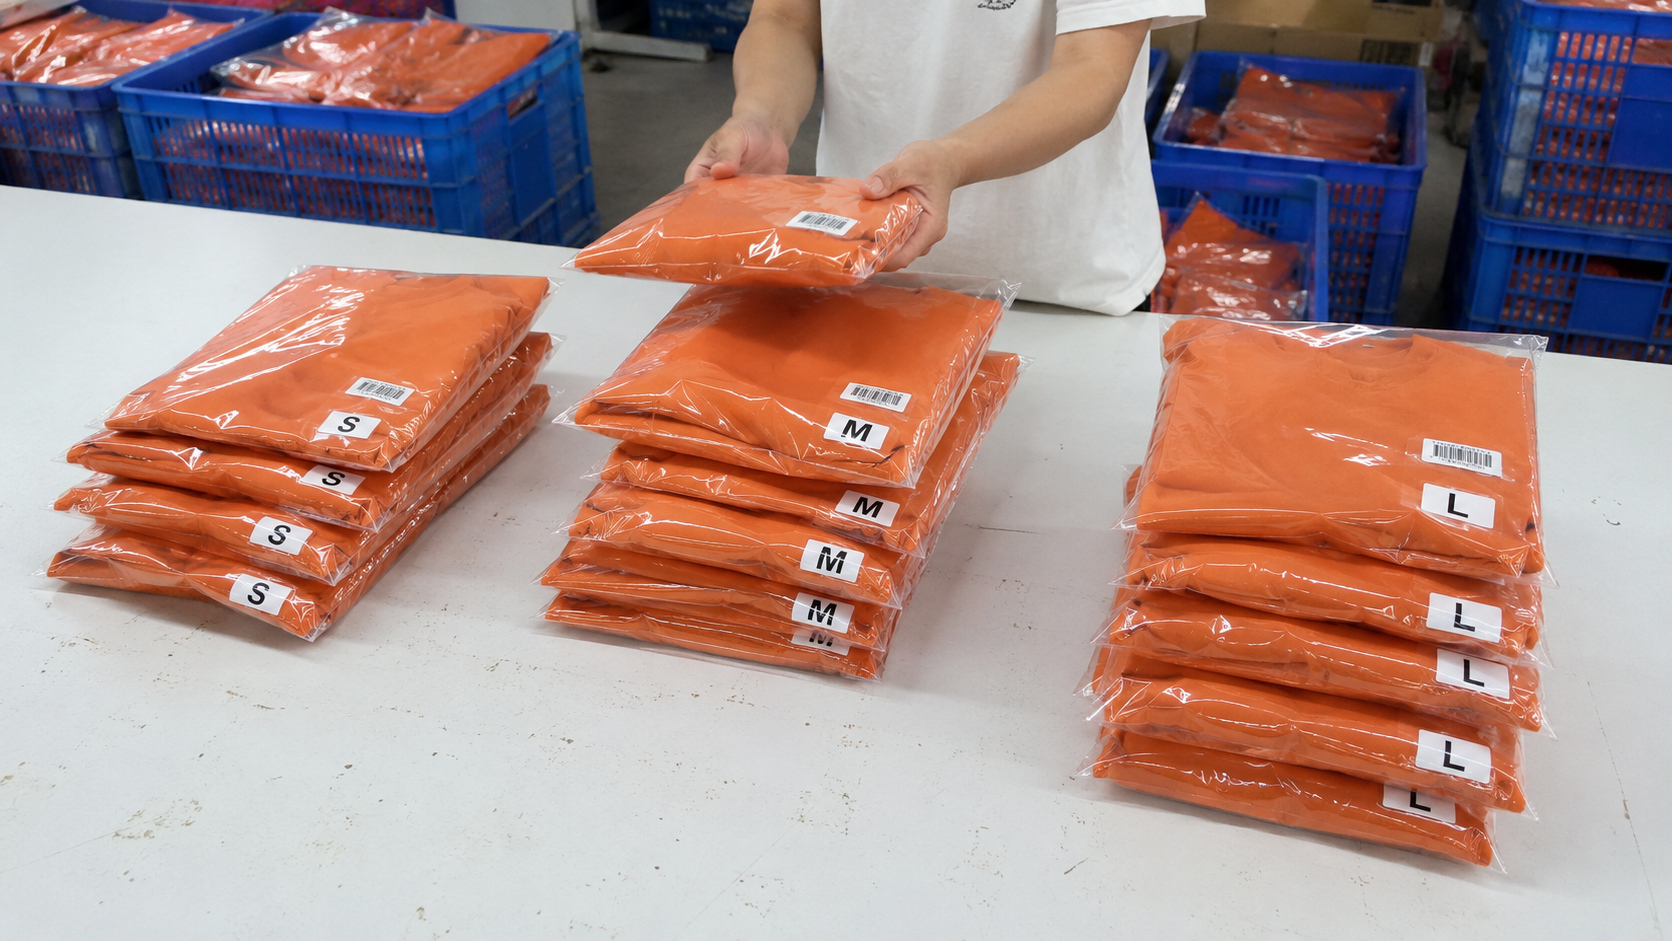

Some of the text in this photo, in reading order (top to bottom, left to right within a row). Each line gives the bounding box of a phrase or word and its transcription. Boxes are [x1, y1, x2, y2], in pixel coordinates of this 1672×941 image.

[338, 416, 360, 433] S
[841, 419, 873, 442] M
[322, 471, 346, 487] S
[852, 496, 883, 518] M
[1447, 492, 1469, 519] L
[268, 524, 291, 545] S
[816, 546, 847, 574] M
[247, 582, 270, 605] S
[807, 599, 837, 626] M
[1453, 602, 1476, 632] L
[1463, 658, 1485, 687] L
[1443, 740, 1465, 772] L
